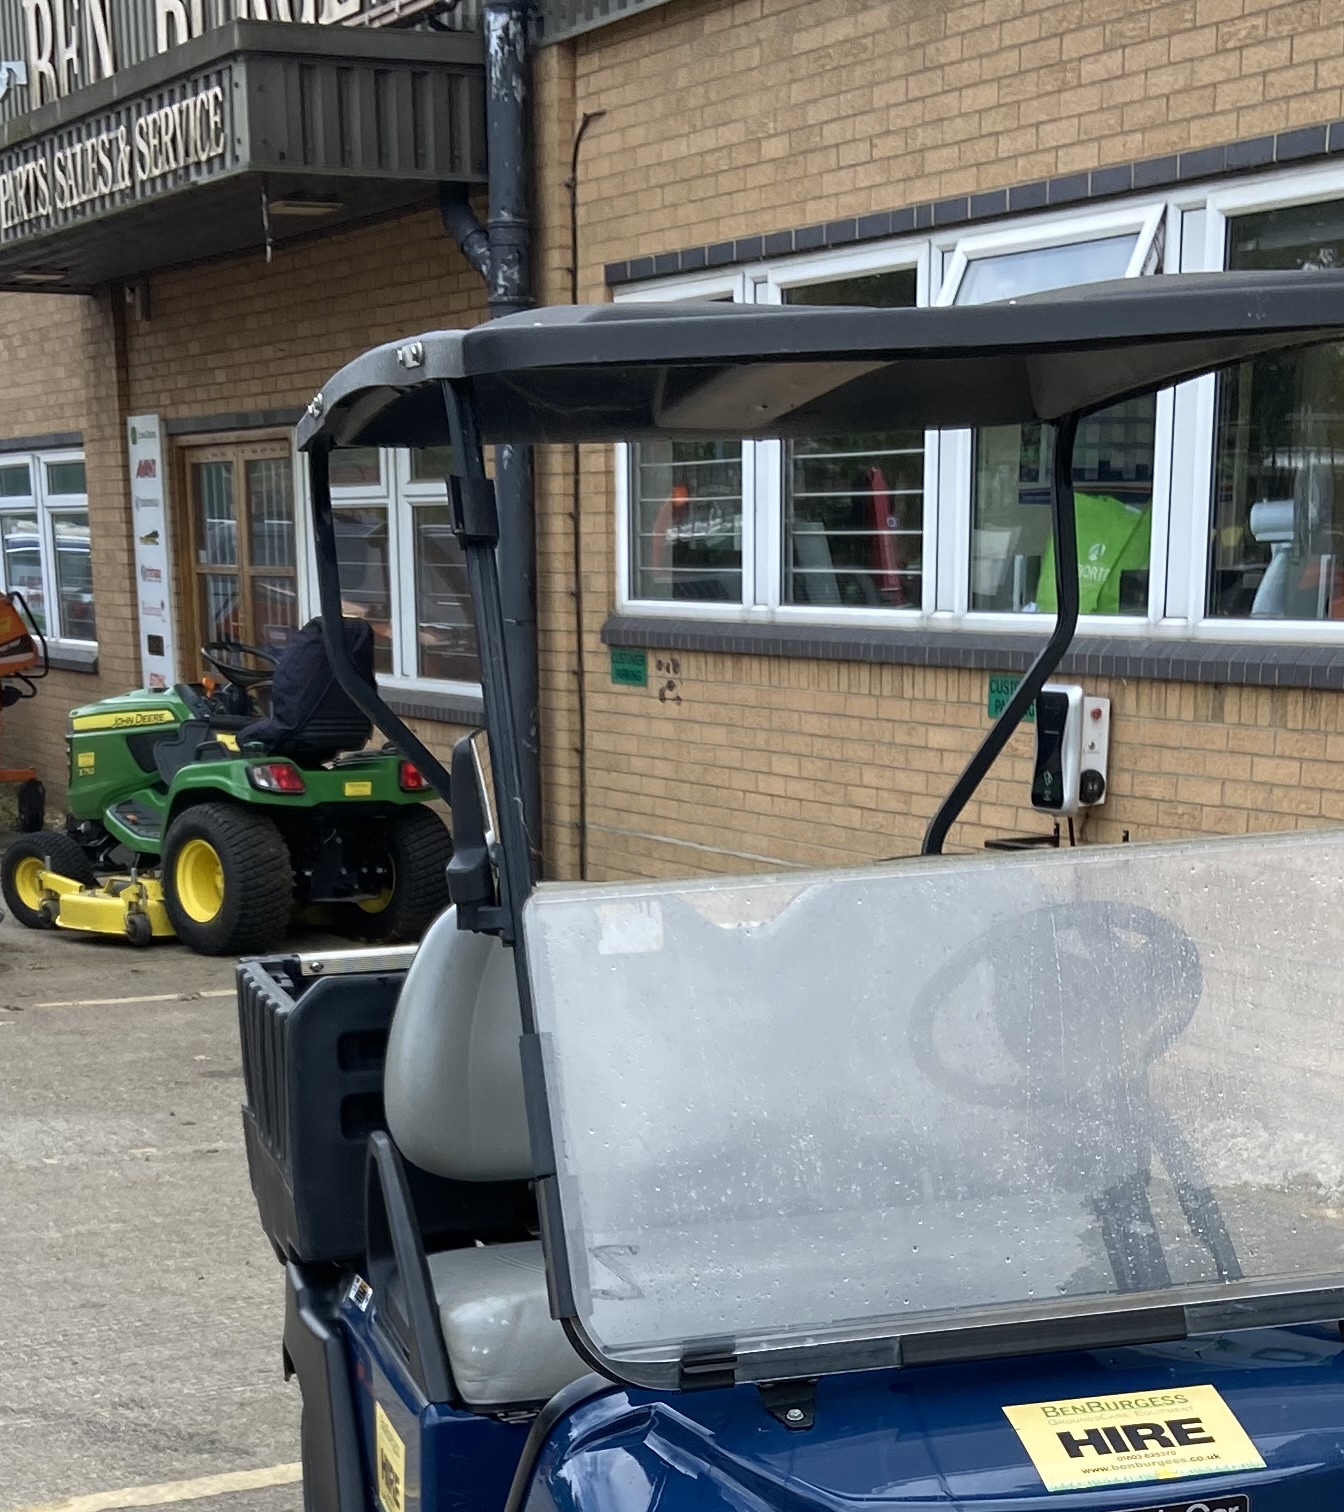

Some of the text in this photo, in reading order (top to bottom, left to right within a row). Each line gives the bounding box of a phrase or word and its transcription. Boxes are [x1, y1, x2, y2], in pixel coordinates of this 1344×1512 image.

[55, 134, 112, 210] SALES
[118, 125, 131, 188] &
[136, 86, 224, 180] SERVICE
[112, 713, 165, 727] JOHN DEERE
[1057, 1417, 1216, 1458] HIRE
[1081, 1453, 1221, 1474] www.benburgess.co.uk
